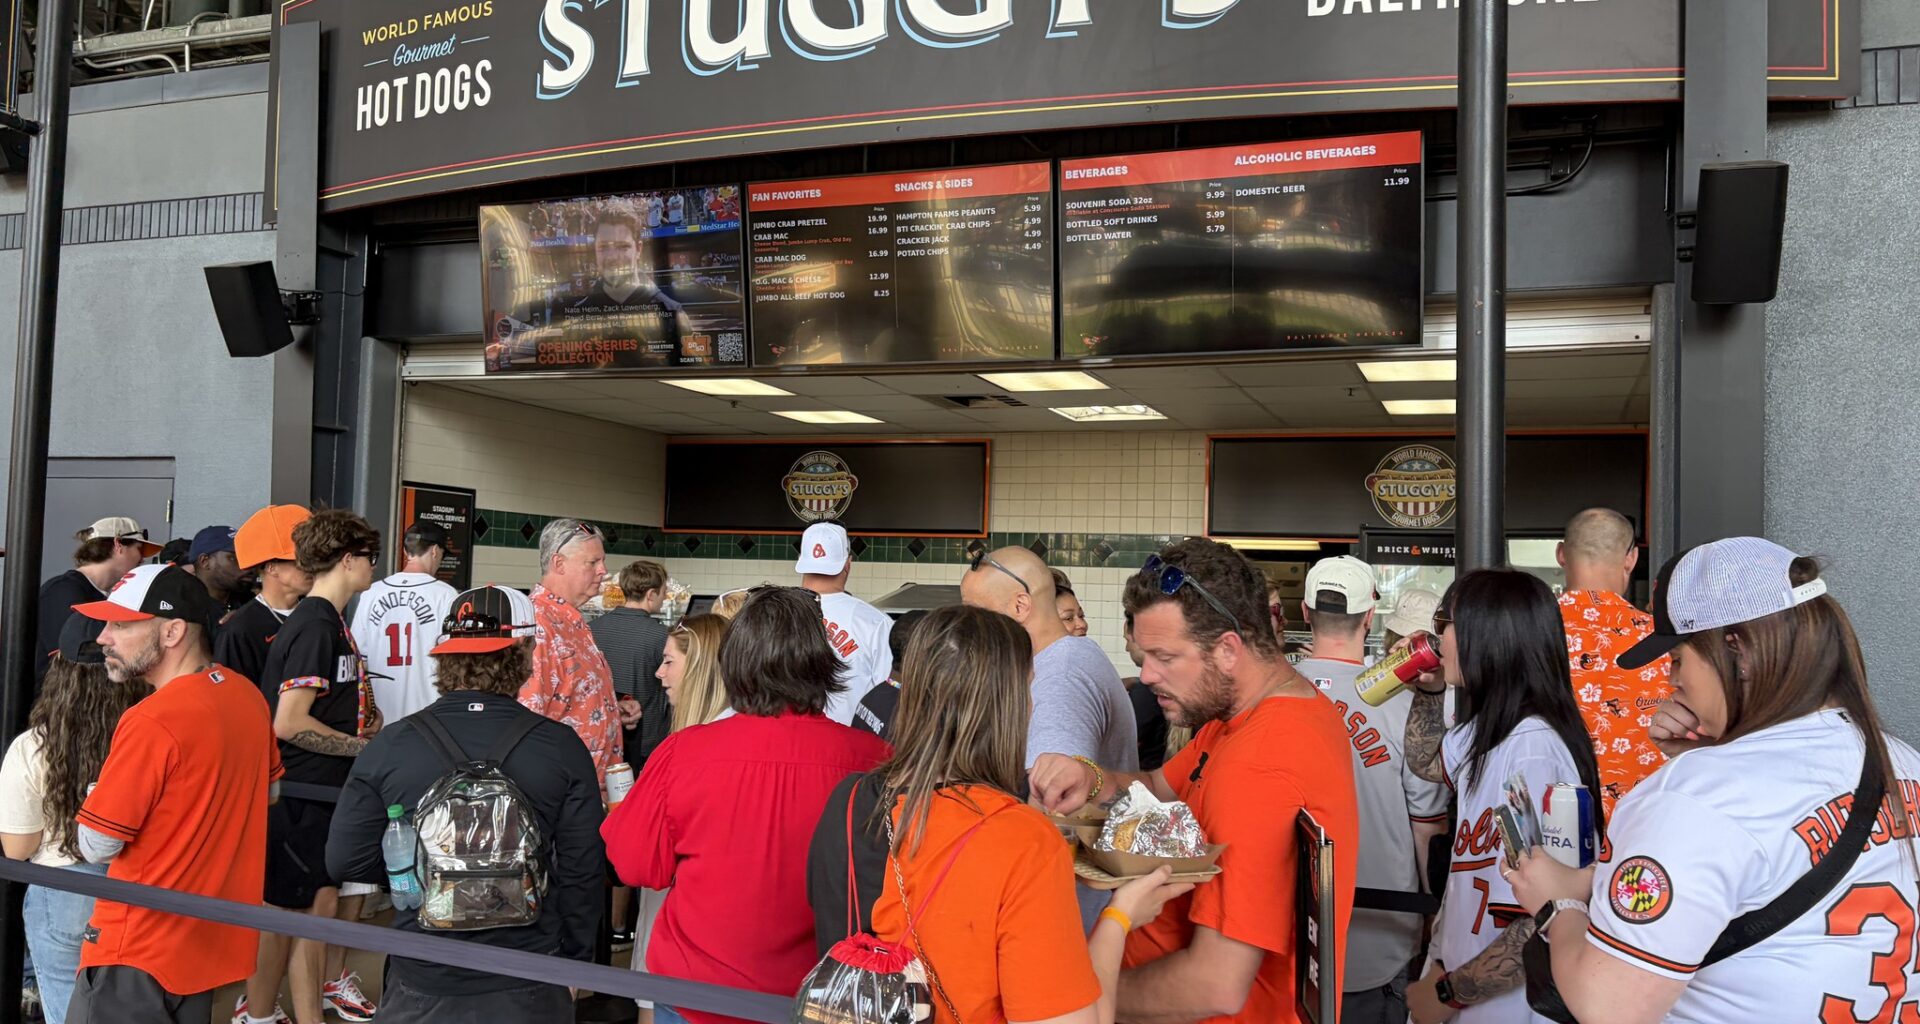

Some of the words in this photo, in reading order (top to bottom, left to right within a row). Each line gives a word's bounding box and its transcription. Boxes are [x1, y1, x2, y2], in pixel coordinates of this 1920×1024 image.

[362, 18, 418, 46] WORLD
[423, 0, 493, 30] FAMOUS
[393, 33, 457, 67] Gourmet
[356, 76, 409, 131] HOT
[414, 59, 492, 119] DOGS
[1234, 151, 1303, 166] ALCOHOLIC
[1305, 145, 1377, 160] BEVERAGES
[1065, 165, 1128, 180] BEVERAGES
[894, 182, 934, 192] SNACKS
[935, 181, 943, 189] &
[944, 178, 973, 188] SIDES
[1384, 177, 1410, 186] 11.99
[752, 192, 770, 202] FAN
[772, 189, 822, 200] FAVORITES
[1205, 191, 1225, 199] 9.99
[1235, 186, 1281, 197] DOMESTIC
[1282, 185, 1305, 194] BEER
[1024, 204, 1041, 212] 5.99
[1065, 200, 1106, 210] SOUVENIR
[1108, 198, 1131, 207] SODA
[1133, 196, 1153, 205] 32oz
[867, 214, 888, 223] 19.99
[896, 212, 933, 221] HAMPTON
[934, 209, 959, 218] FARMS
[961, 207, 996, 216] PEANUTS
[1205, 210, 1225, 219] 5.99
[753, 221, 776, 230] JUMBO
[777, 220, 796, 228] CRAB
[797, 218, 827, 227] PRETZEL
[945, 222, 966, 230] CRAB
[967, 220, 990, 228] CHIPS
[1024, 217, 1041, 225] 4.99
[1066, 219, 1102, 229] BOTTLED
[1103, 217, 1125, 226] SOFT
[1127, 215, 1158, 224] DRINKS
[868, 227, 888, 235] 16.99
[1024, 230, 1041, 238] 4.99
[1205, 224, 1225, 233] 5.79
[753, 233, 772, 241] CRAB
[773, 232, 789, 240] MAC
[896, 236, 930, 245] CRACKER
[931, 235, 950, 244] JACK
[1066, 233, 1102, 242] BOTTLED
[1103, 231, 1132, 240] WATER
[1024, 242, 1042, 250] 4.49
[868, 250, 889, 258] 16.99
[896, 249, 926, 257] POTATO
[927, 248, 949, 256] CHIPS
[869, 273, 889, 281] 12.99
[756, 294, 779, 302] JUMBO
[780, 291, 812, 300] ALL-BEEF
[829, 291, 845, 299] DOG
[538, 340, 592, 353] OPENING
[595, 338, 638, 351] SERIES
[538, 351, 614, 364] COLLECTION
[791, 484, 849, 495] STUGGY'S
[1379, 484, 1456, 497] STUGGY'S
[432, 505, 455, 513] STADIUM
[420, 512, 444, 520] ALCOHOL
[445, 514, 466, 523] SERVICE
[1411, 545, 1421, 556] &
[368, 590, 436, 626] HENDERSON
[385, 622, 412, 667] 11
[1541, 834, 1576, 849] TRA.
